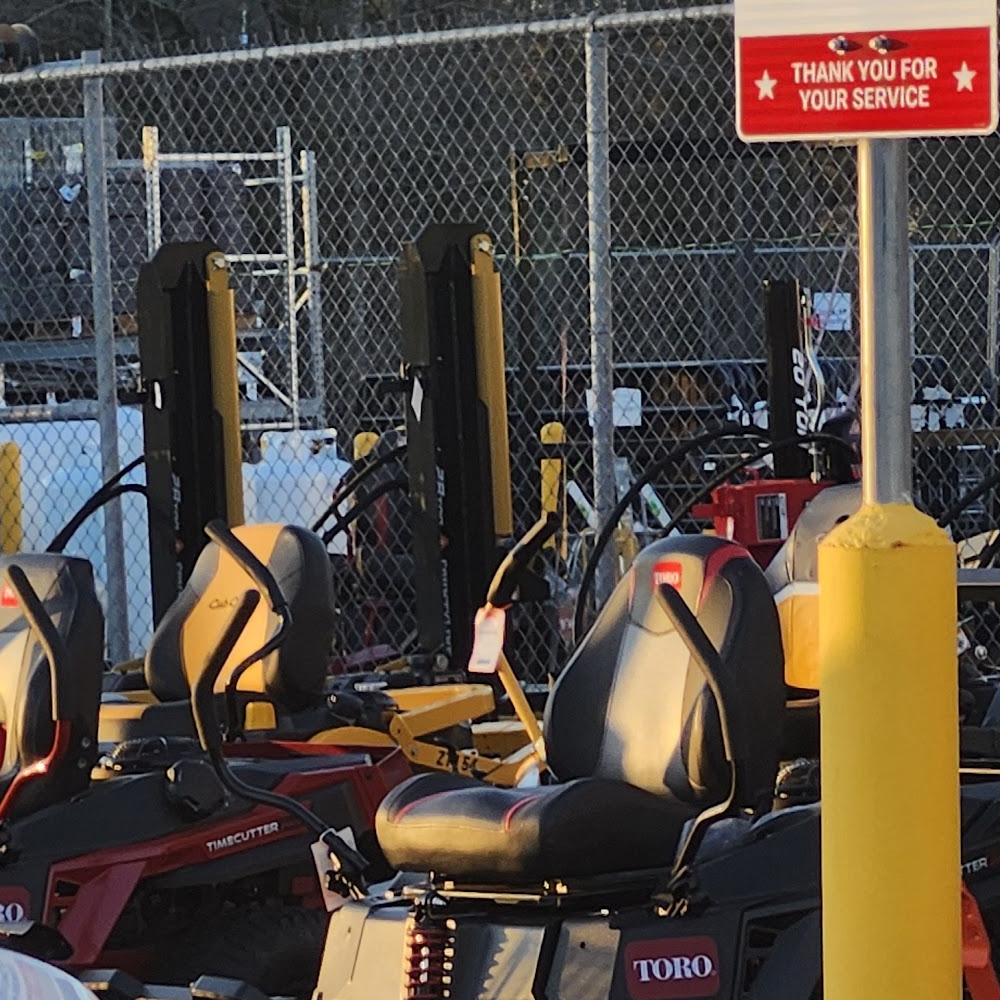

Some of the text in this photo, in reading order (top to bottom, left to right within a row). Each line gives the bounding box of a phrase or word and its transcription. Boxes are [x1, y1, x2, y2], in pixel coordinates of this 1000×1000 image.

[791, 57, 937, 84] THANK YOU FOR
[799, 85, 930, 112] YOUR SERVICE
[206, 822, 279, 852] TIMECUTTER
[632, 954, 712, 982] TORO
